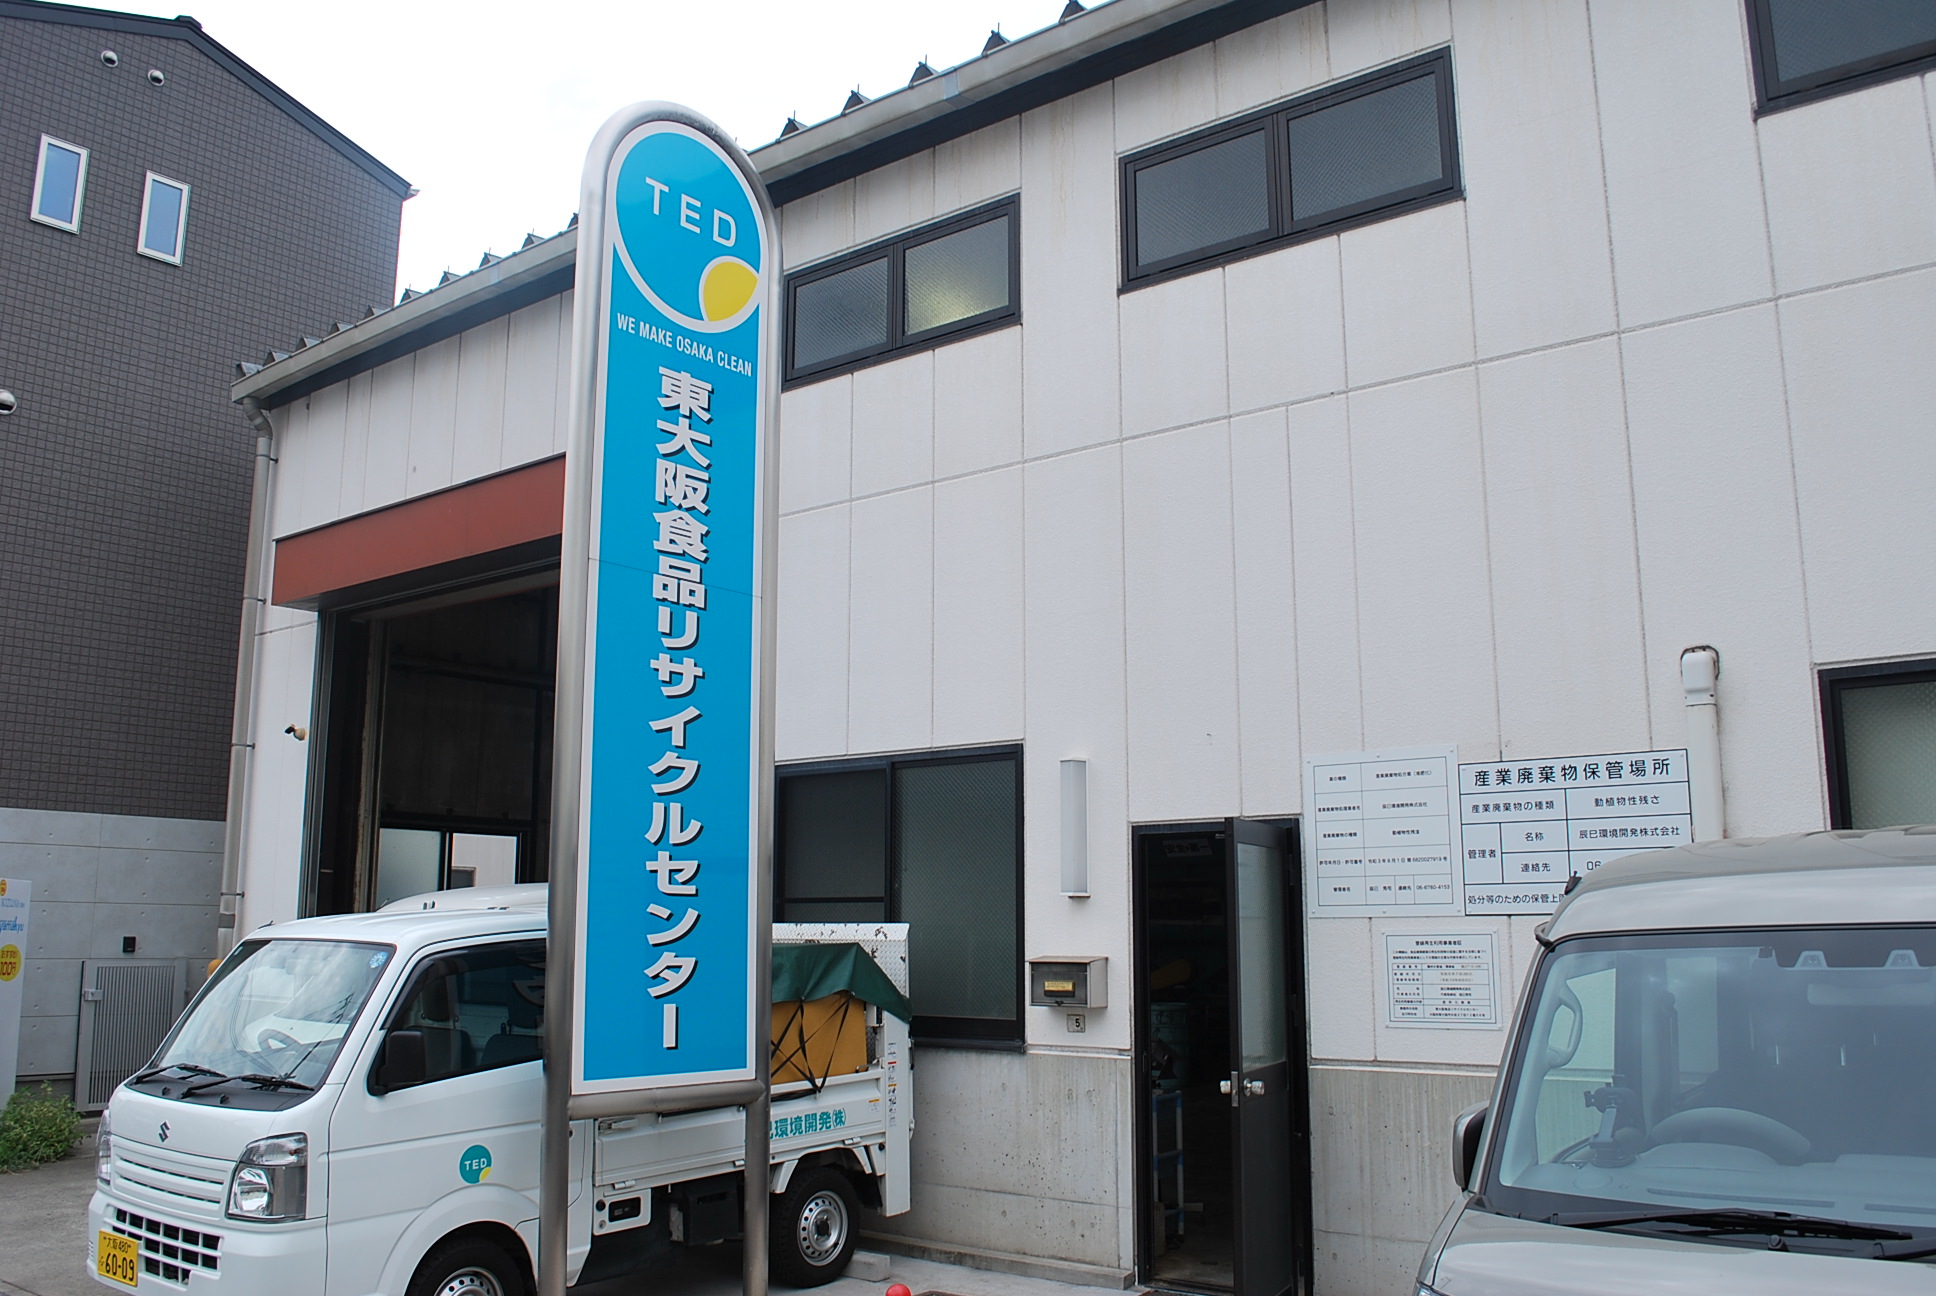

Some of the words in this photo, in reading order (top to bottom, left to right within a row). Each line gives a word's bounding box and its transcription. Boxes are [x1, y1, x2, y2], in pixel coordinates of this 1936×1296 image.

[645, 176, 737, 247] TED
[617, 312, 635, 334] WE
[639, 323, 672, 348] MAKE
[676, 335, 713, 362] OSAKA
[717, 350, 752, 377] CLEAN
[644, 366, 713, 1049] 東大阪食品リサイクルセンター
[1474, 758, 1671, 786] 産業廃棄物保管場所
[1471, 801, 1555, 813] 産業廃棄物の種類
[1594, 795, 1660, 808] 動植物性残さ
[1524, 831, 1544, 841] 名称
[1579, 826, 1680, 839] 辰巳環境開発株式会社
[1467, 849, 1497, 859] 管理者
[1520, 863, 1551, 873] 連絡先
[1075, 1018, 1081, 1028] 5
[464, 1158, 488, 1171] TED
[105, 1252, 135, 1282] 60-09
